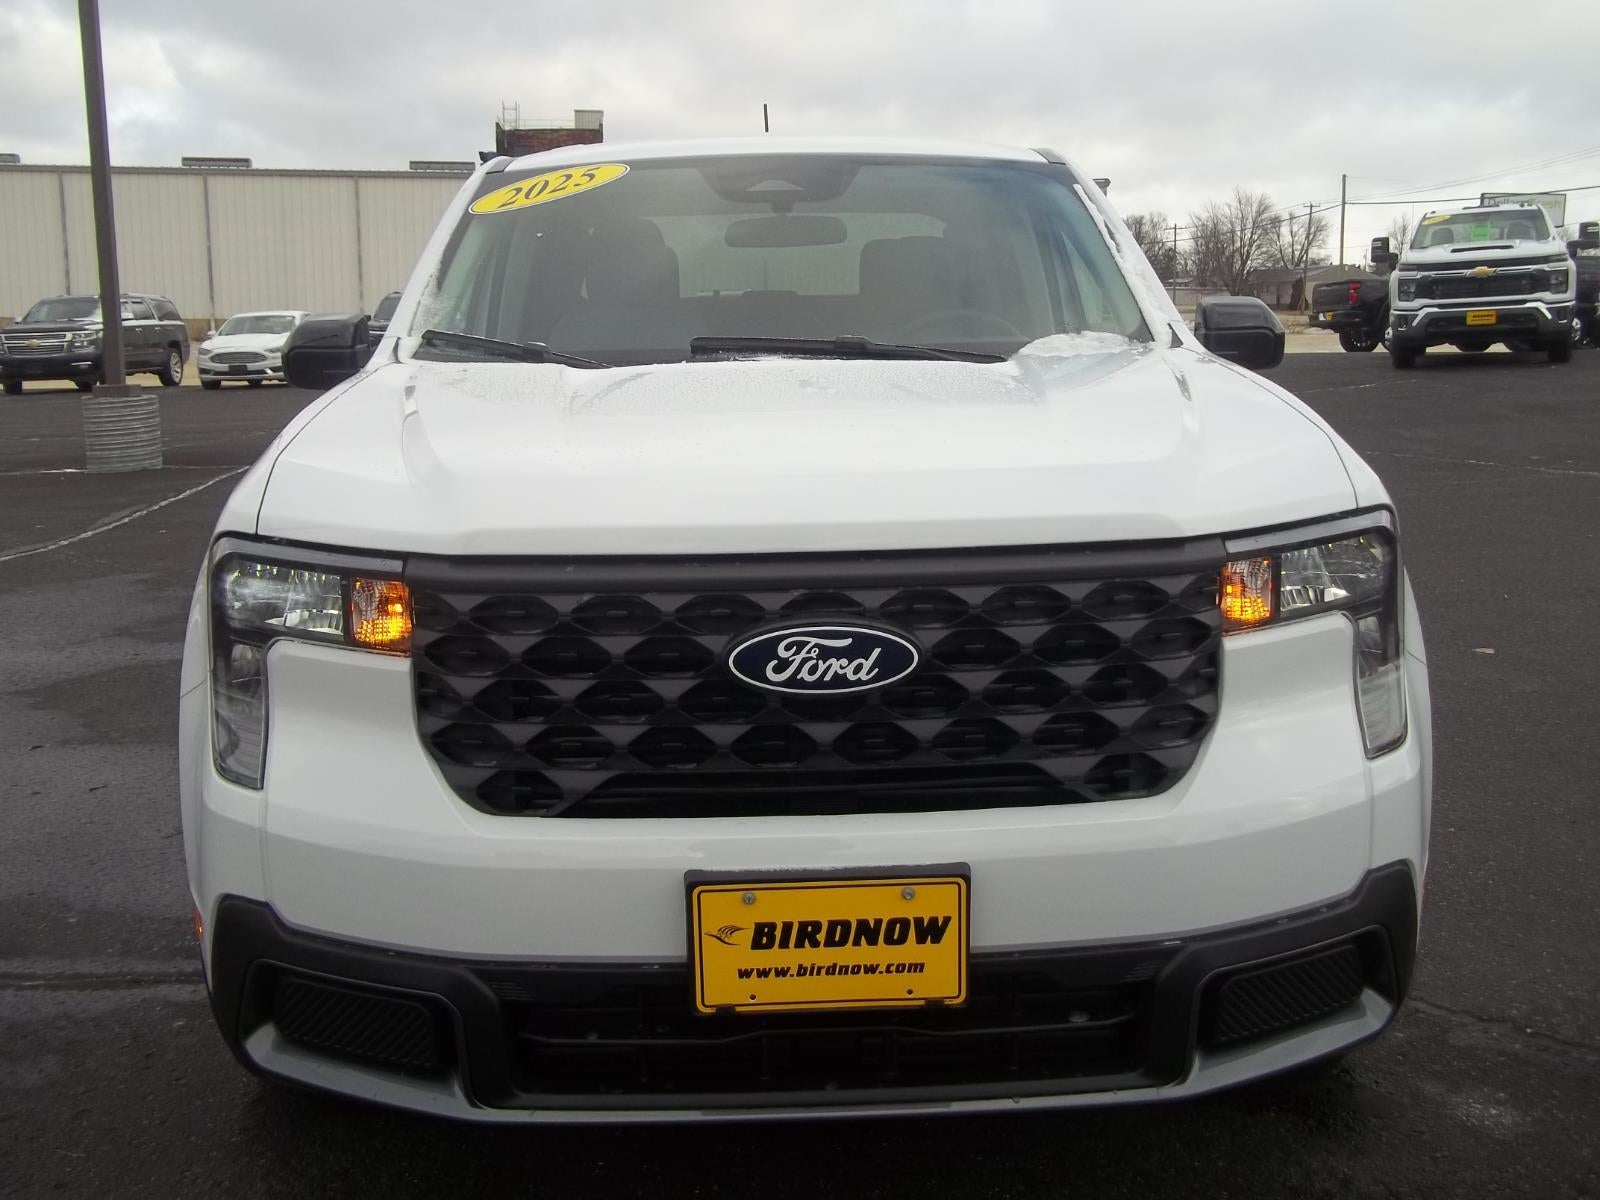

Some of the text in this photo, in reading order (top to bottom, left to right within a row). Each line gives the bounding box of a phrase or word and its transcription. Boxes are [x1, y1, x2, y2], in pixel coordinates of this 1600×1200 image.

[496, 166, 601, 209] 2025
[765, 636, 882, 682] Ford
[750, 916, 952, 950] BIRDNOW
[737, 961, 925, 979] www.birdnow.com
